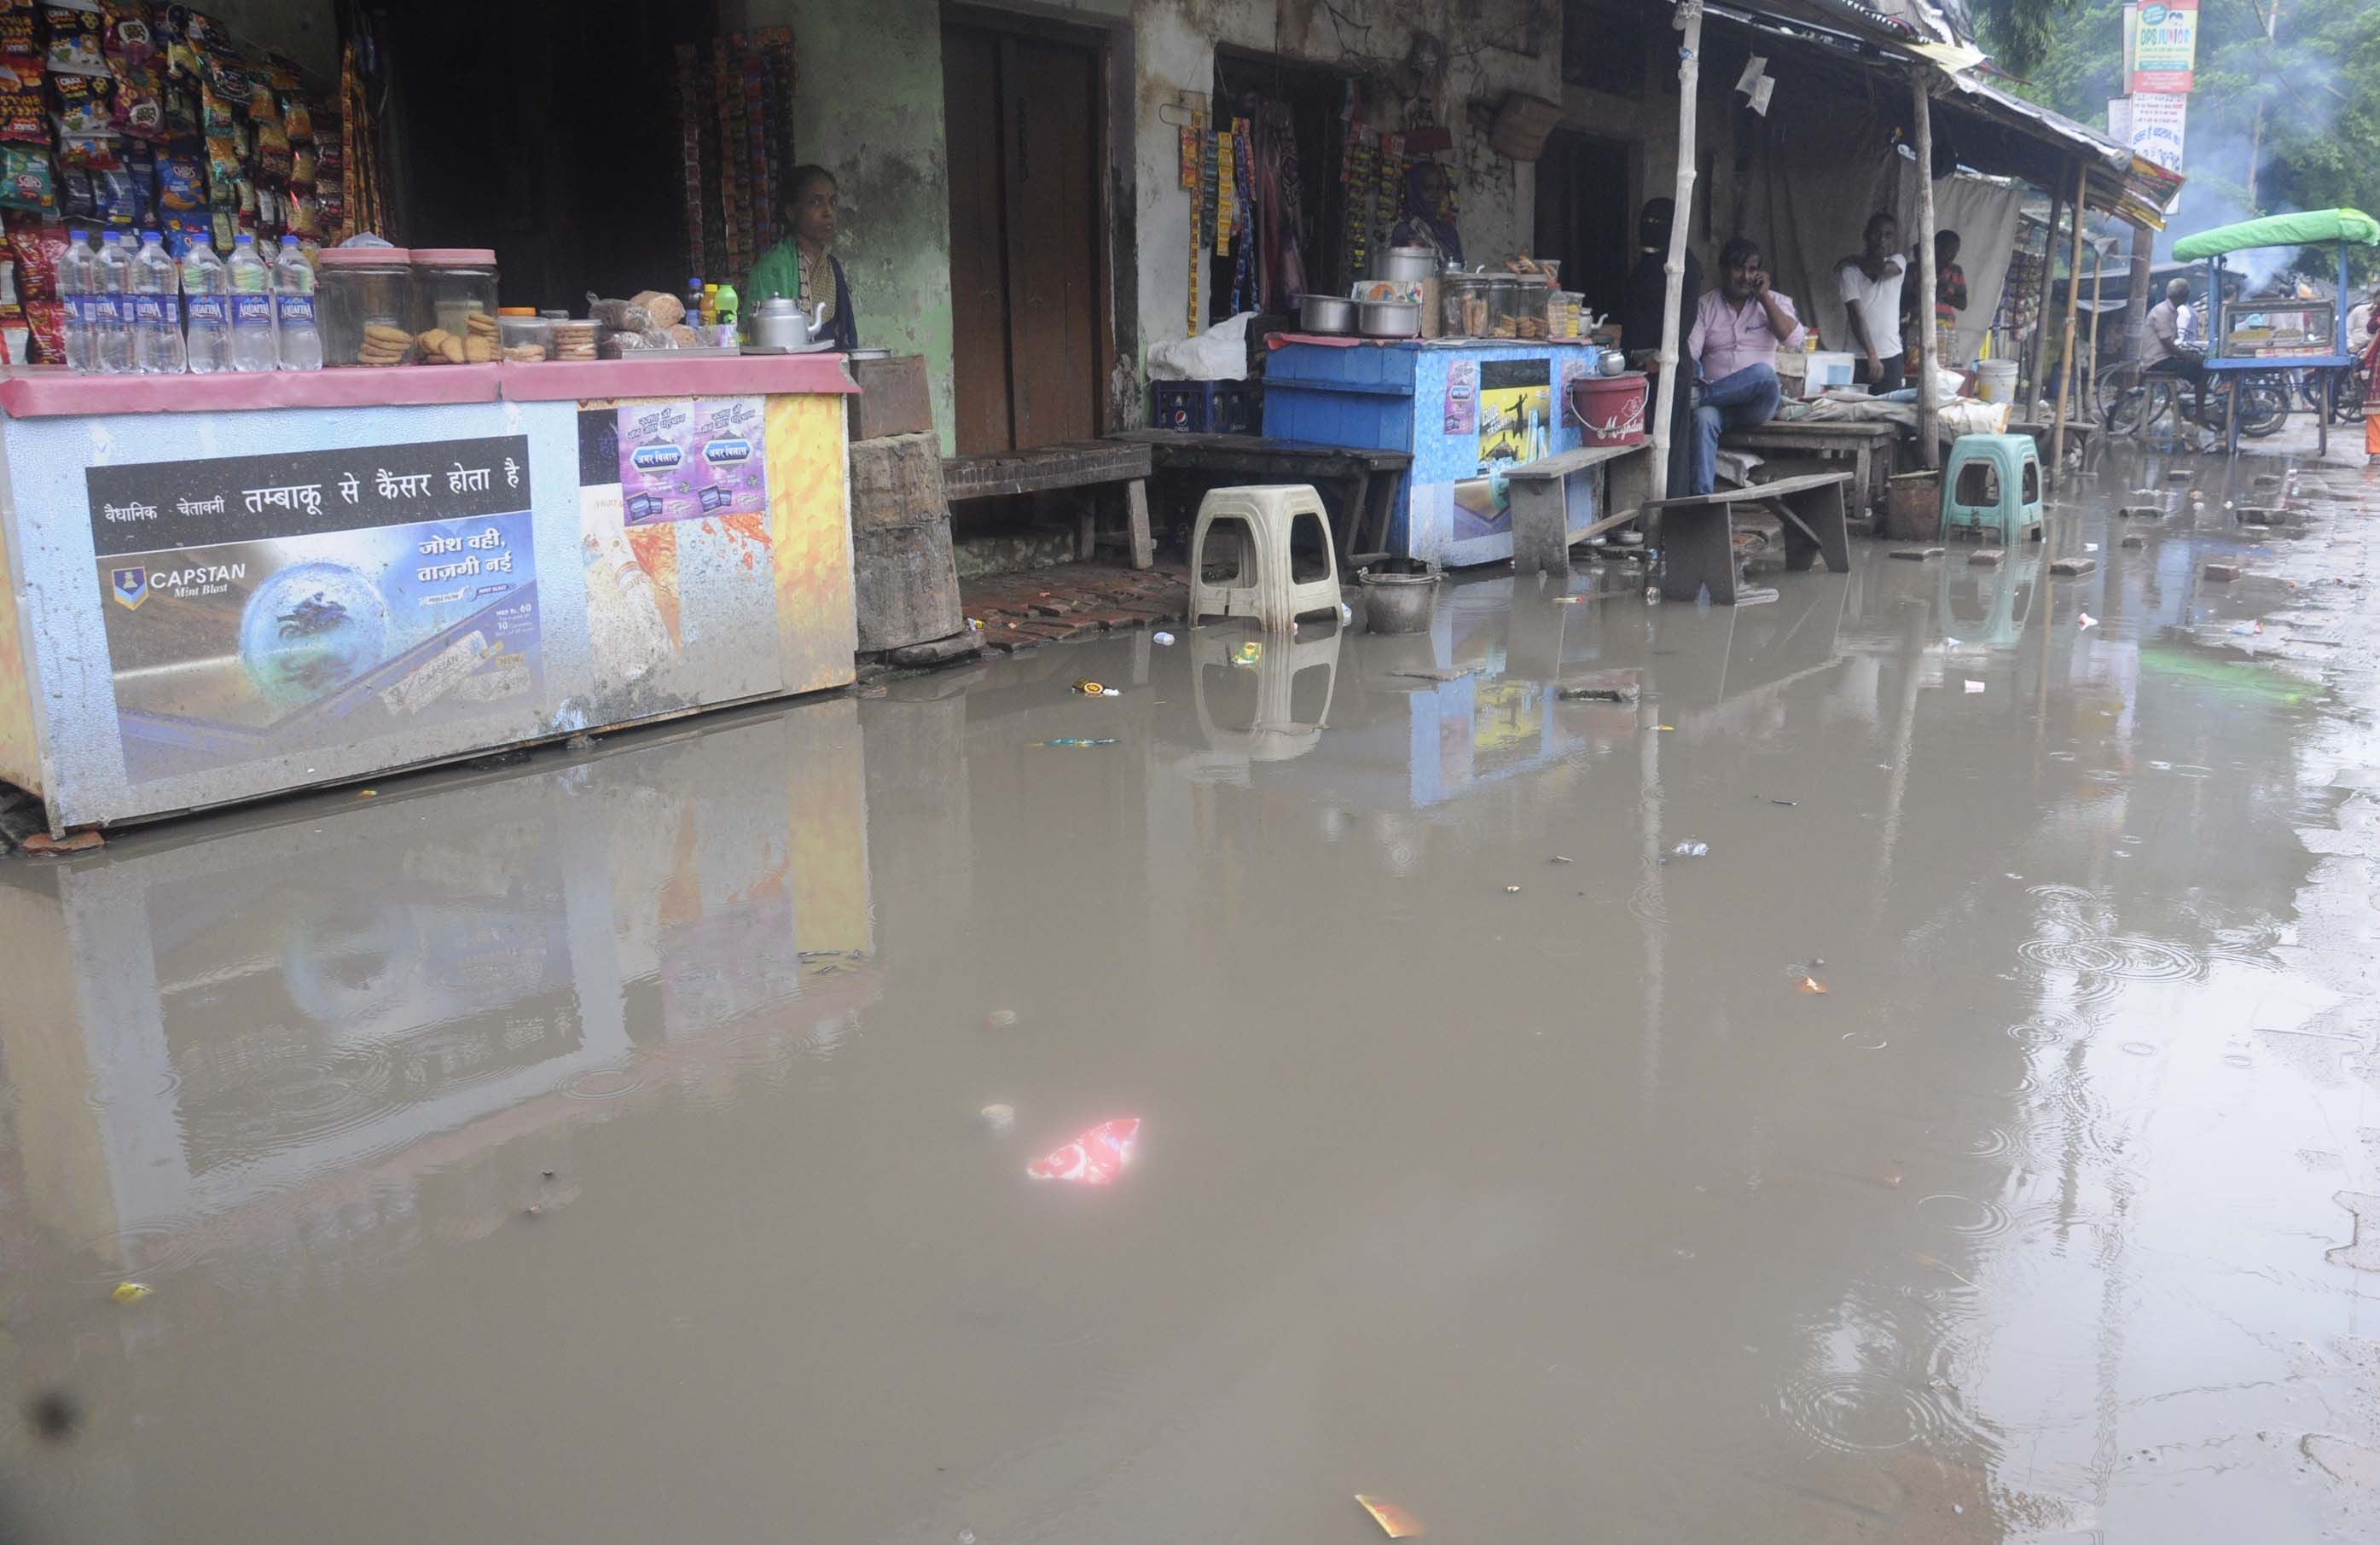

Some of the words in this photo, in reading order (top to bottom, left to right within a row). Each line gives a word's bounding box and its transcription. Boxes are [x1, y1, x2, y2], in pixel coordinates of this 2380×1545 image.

[189, 301, 222, 318] AQUAFINA
[281, 302, 312, 318] AQUAFINA
[1483, 404, 1498, 426] COOL
[103, 502, 157, 523] वैधानिक
[177, 495, 225, 516] चेतावनी
[242, 484, 322, 516] तम्बाकू
[338, 473, 360, 504] से
[375, 468, 432, 499] कैंसर
[446, 462, 491, 493] होता
[504, 457, 520, 488] है
[418, 535, 463, 555] जोश
[467, 527, 506, 550] वही,
[416, 555, 481, 582] ताज़गी
[485, 550, 513, 572] नई
[150, 563, 247, 589] CAPSTAN
[174, 585, 199, 598] Mint
[202, 584, 228, 595] Blast
[520, 603, 531, 613] 60
[498, 621, 508, 630] 10
